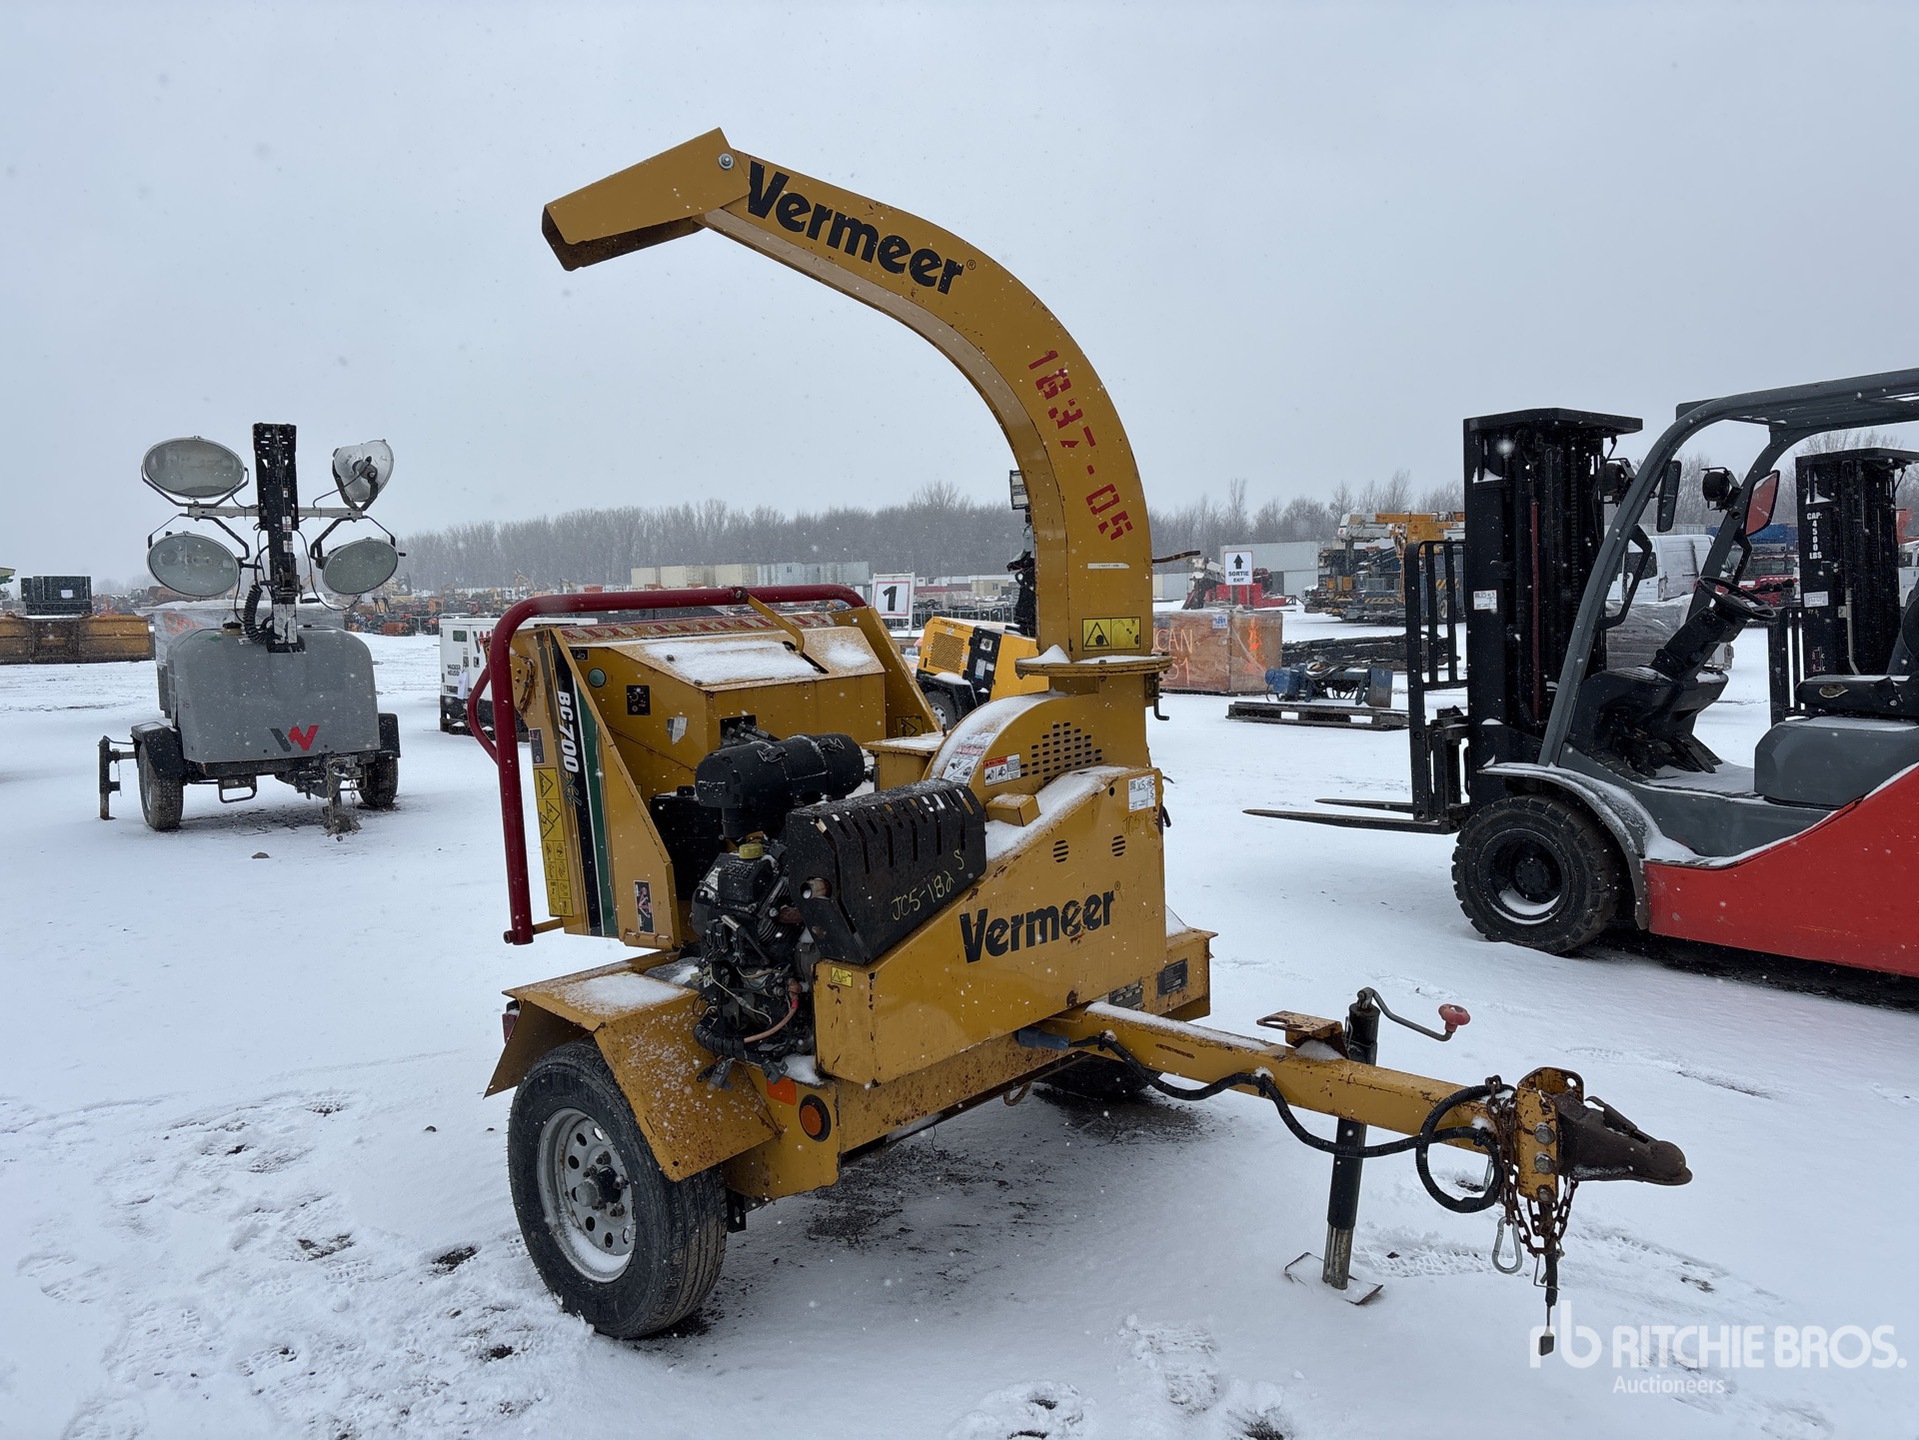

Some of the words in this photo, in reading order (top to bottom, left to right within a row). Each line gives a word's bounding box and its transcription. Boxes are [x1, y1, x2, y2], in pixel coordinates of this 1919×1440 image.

[748, 160, 965, 295] Vermeer
[882, 585, 898, 612] 1
[557, 690, 580, 773] BC700
[891, 870, 955, 920] JC5-182
[959, 890, 1115, 964] Vermeer
